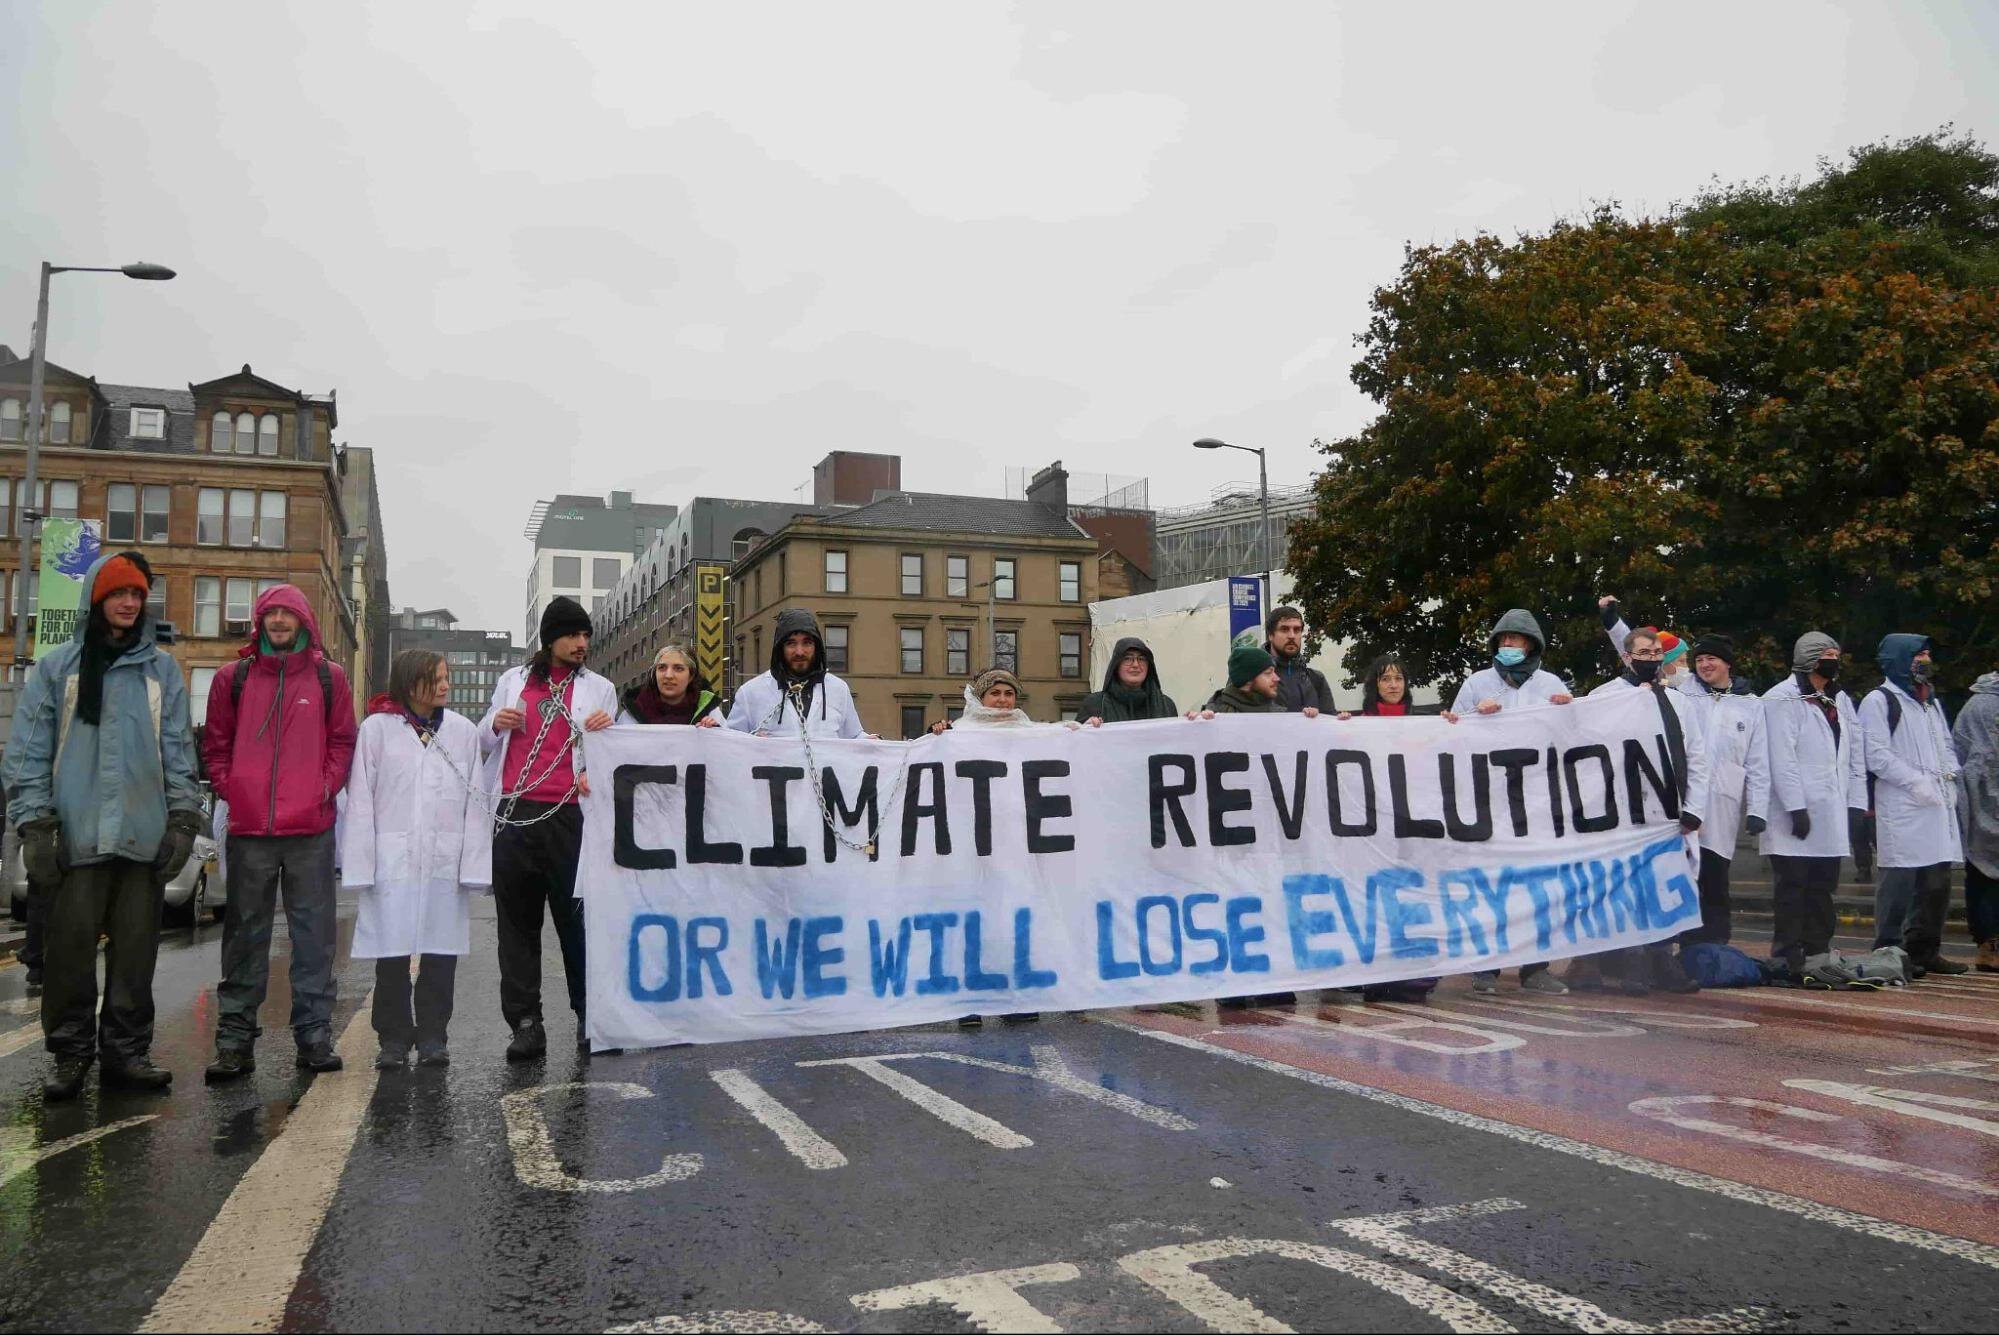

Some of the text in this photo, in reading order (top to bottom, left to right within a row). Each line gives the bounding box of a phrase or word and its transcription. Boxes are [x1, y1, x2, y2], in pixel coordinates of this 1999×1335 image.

[704, 575, 717, 592] P
[40, 633, 73, 645] PLANE
[41, 621, 61, 633] FOR
[613, 734, 1682, 870] CLIMATE REVOLUTION
[627, 837, 1700, 1001] OR WE WILL LOSE EVERYTHING
[500, 1044, 1198, 1193] CITY
